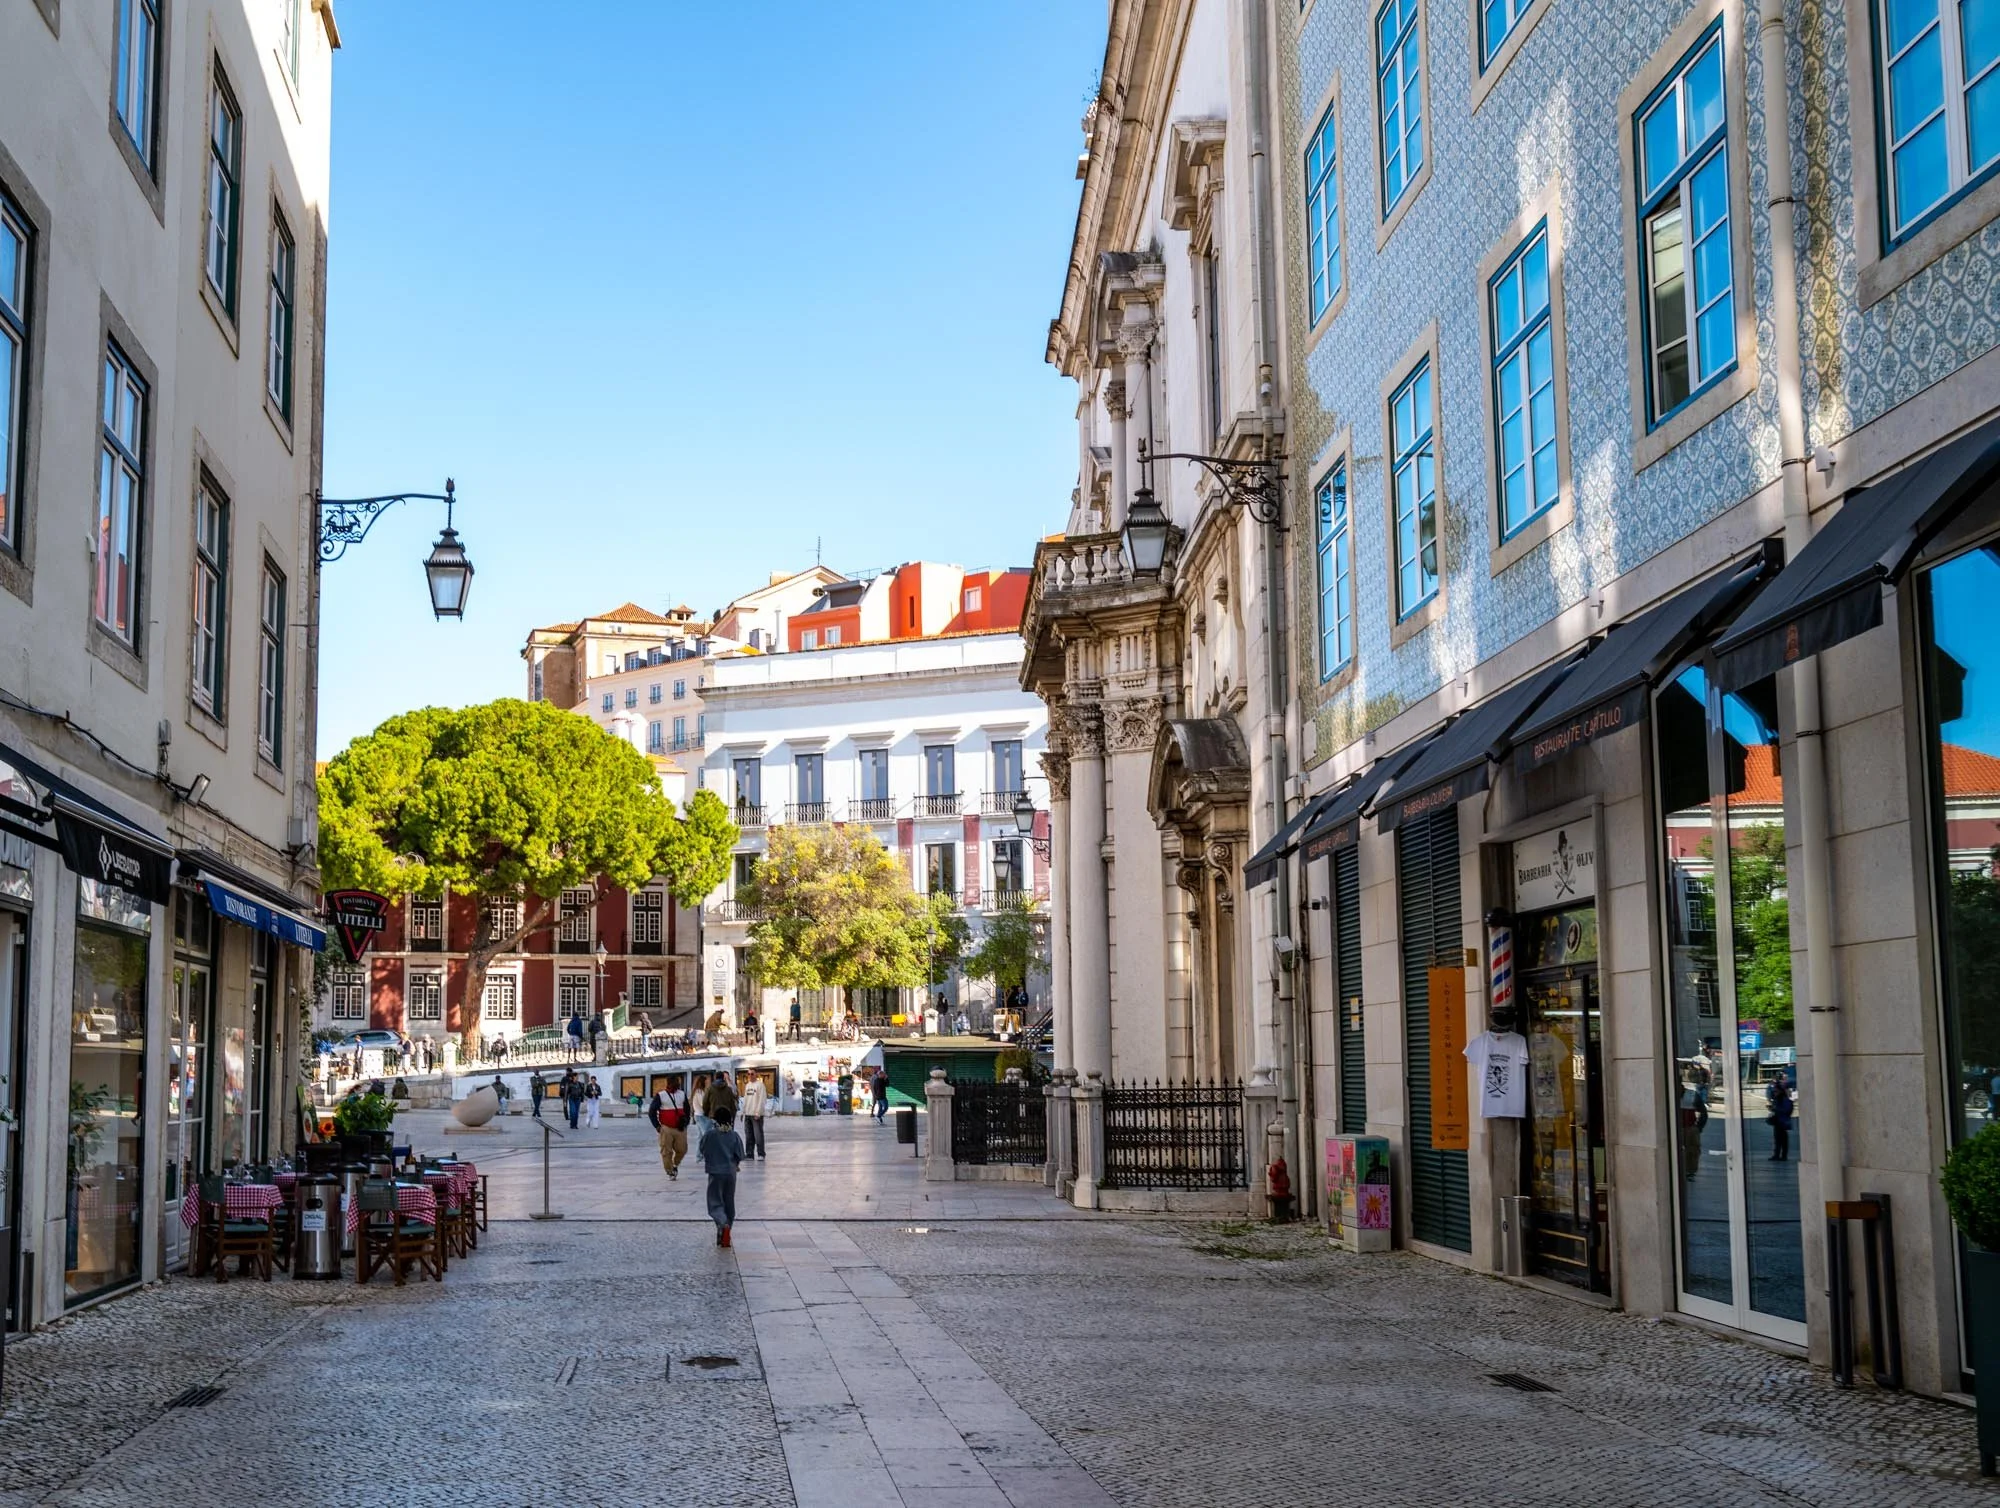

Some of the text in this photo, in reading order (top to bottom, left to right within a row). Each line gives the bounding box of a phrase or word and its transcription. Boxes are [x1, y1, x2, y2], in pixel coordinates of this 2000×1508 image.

[224, 894, 257, 923] RISTORANTE
[342, 896, 377, 908] RISTORANTE
[336, 911, 383, 929] VITELLI
[294, 922, 313, 946] VITELLI
